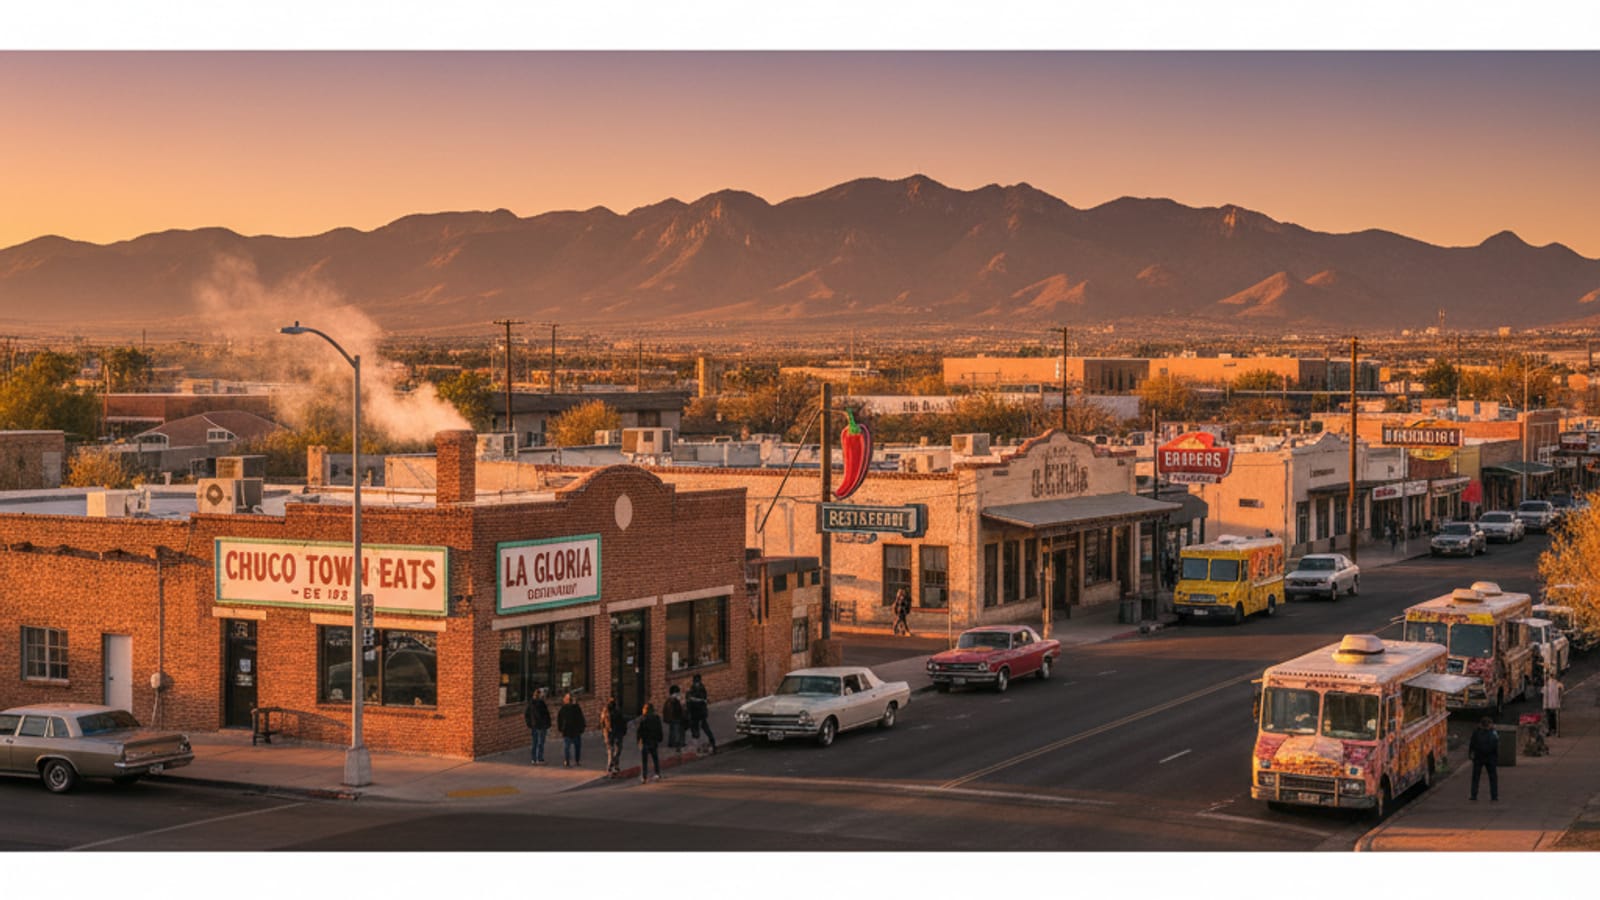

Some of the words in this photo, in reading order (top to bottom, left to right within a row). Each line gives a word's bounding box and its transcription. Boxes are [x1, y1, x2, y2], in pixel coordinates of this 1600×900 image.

[225, 550, 296, 583] CHUCO
[306, 554, 369, 588] TOWN
[379, 558, 436, 590] EATS
[506, 554, 528, 588] LA
[534, 547, 592, 584] GLORIA
